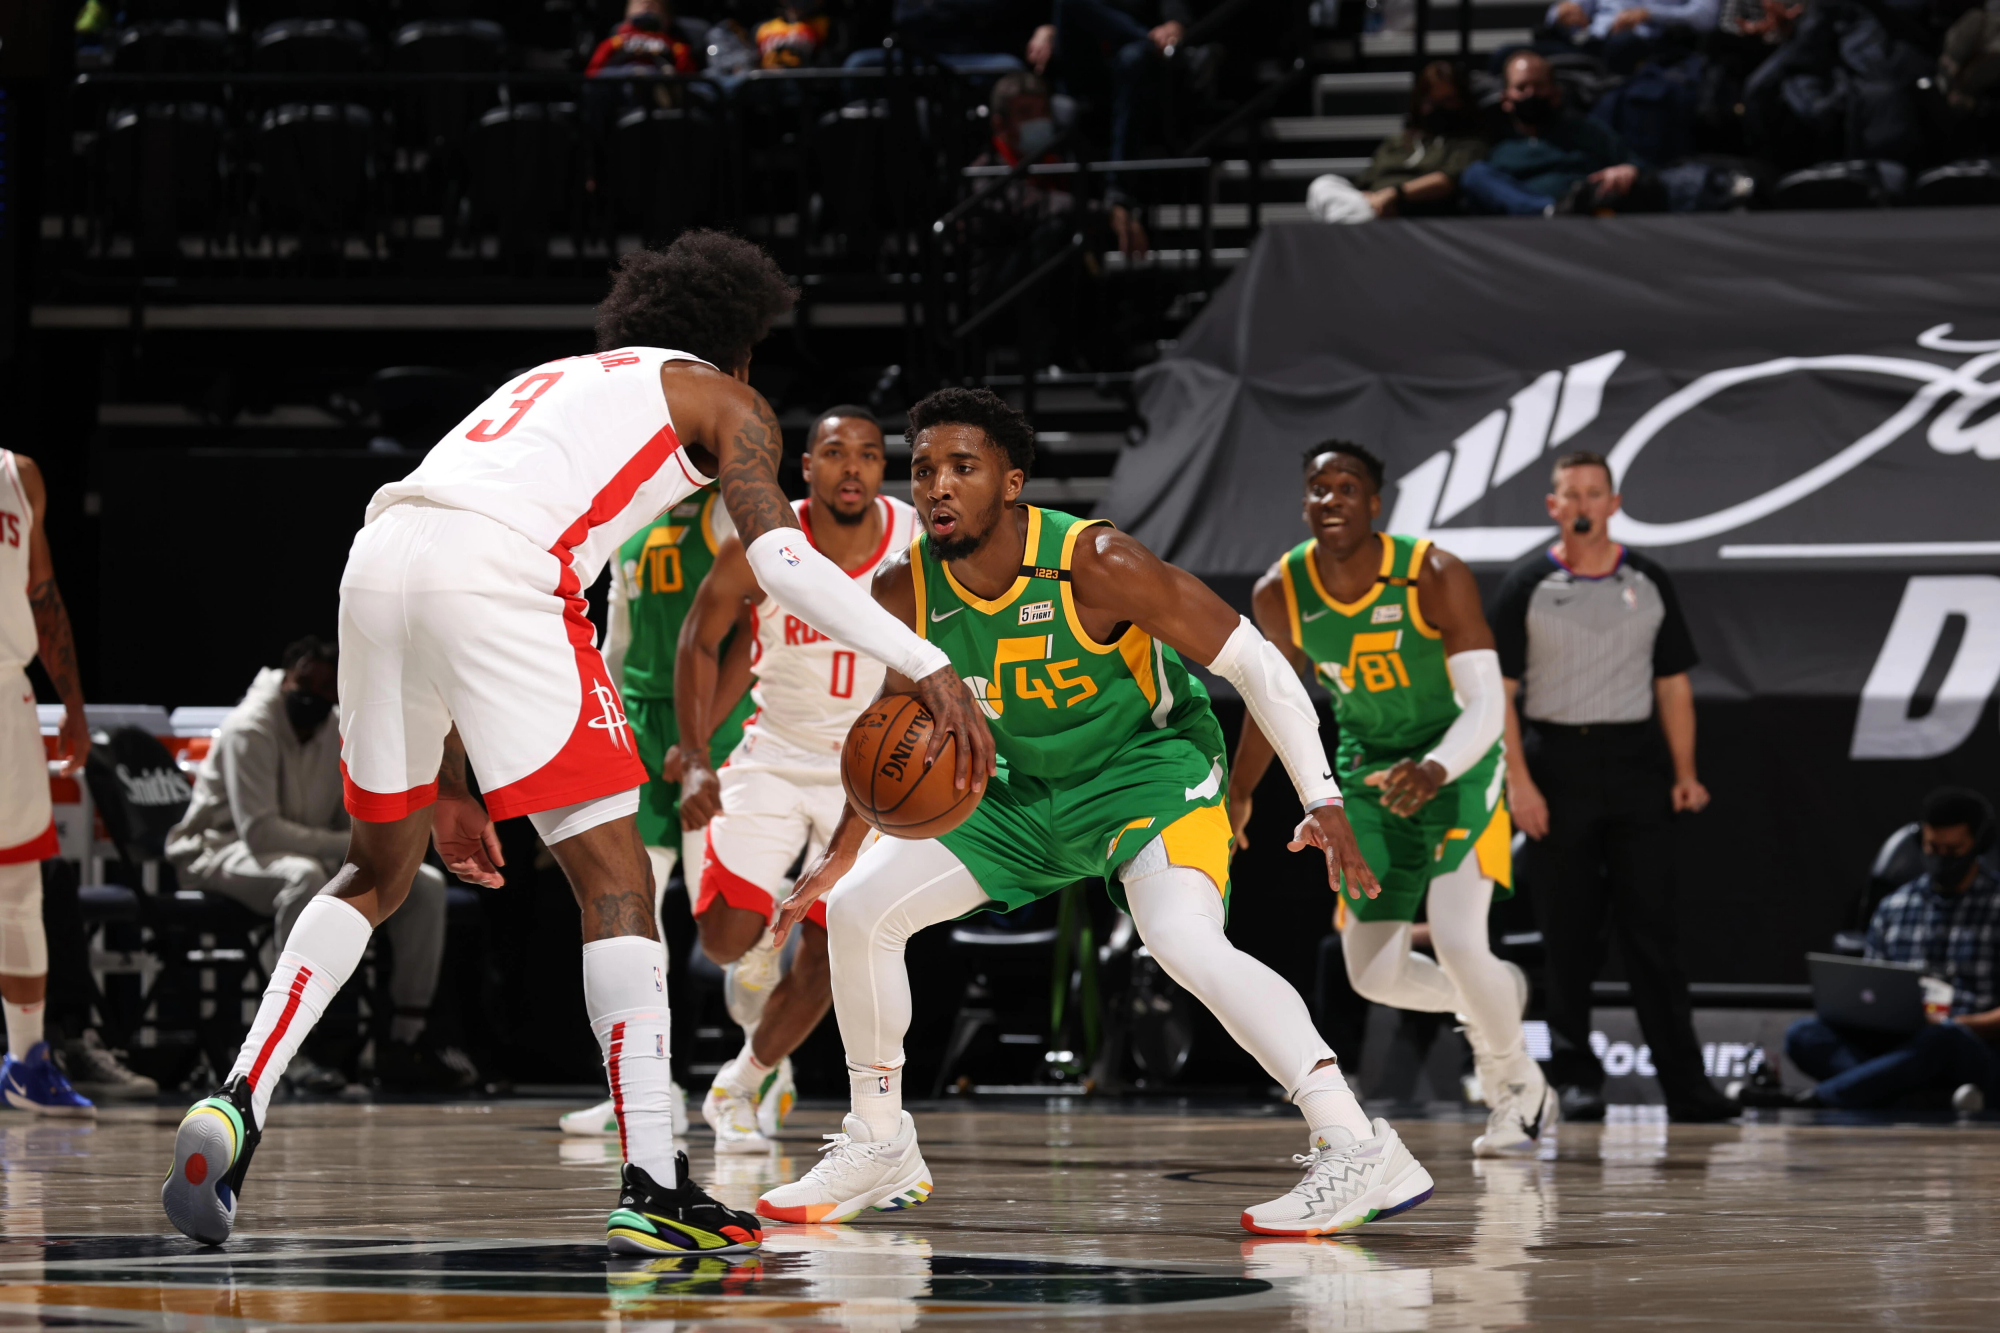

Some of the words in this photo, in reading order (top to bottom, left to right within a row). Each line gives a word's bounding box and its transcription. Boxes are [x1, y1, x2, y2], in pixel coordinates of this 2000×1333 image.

[465, 370, 564, 442] 3
[648, 546, 684, 594] 10
[1035, 568, 1058, 579] 1223
[1022, 607, 1029, 622] 5
[1032, 611, 1051, 620] FIGHT
[829, 651, 855, 699] 0
[1015, 658, 1098, 709] 45
[1357, 651, 1411, 693] 81
[880, 709, 932, 782] ALDING
